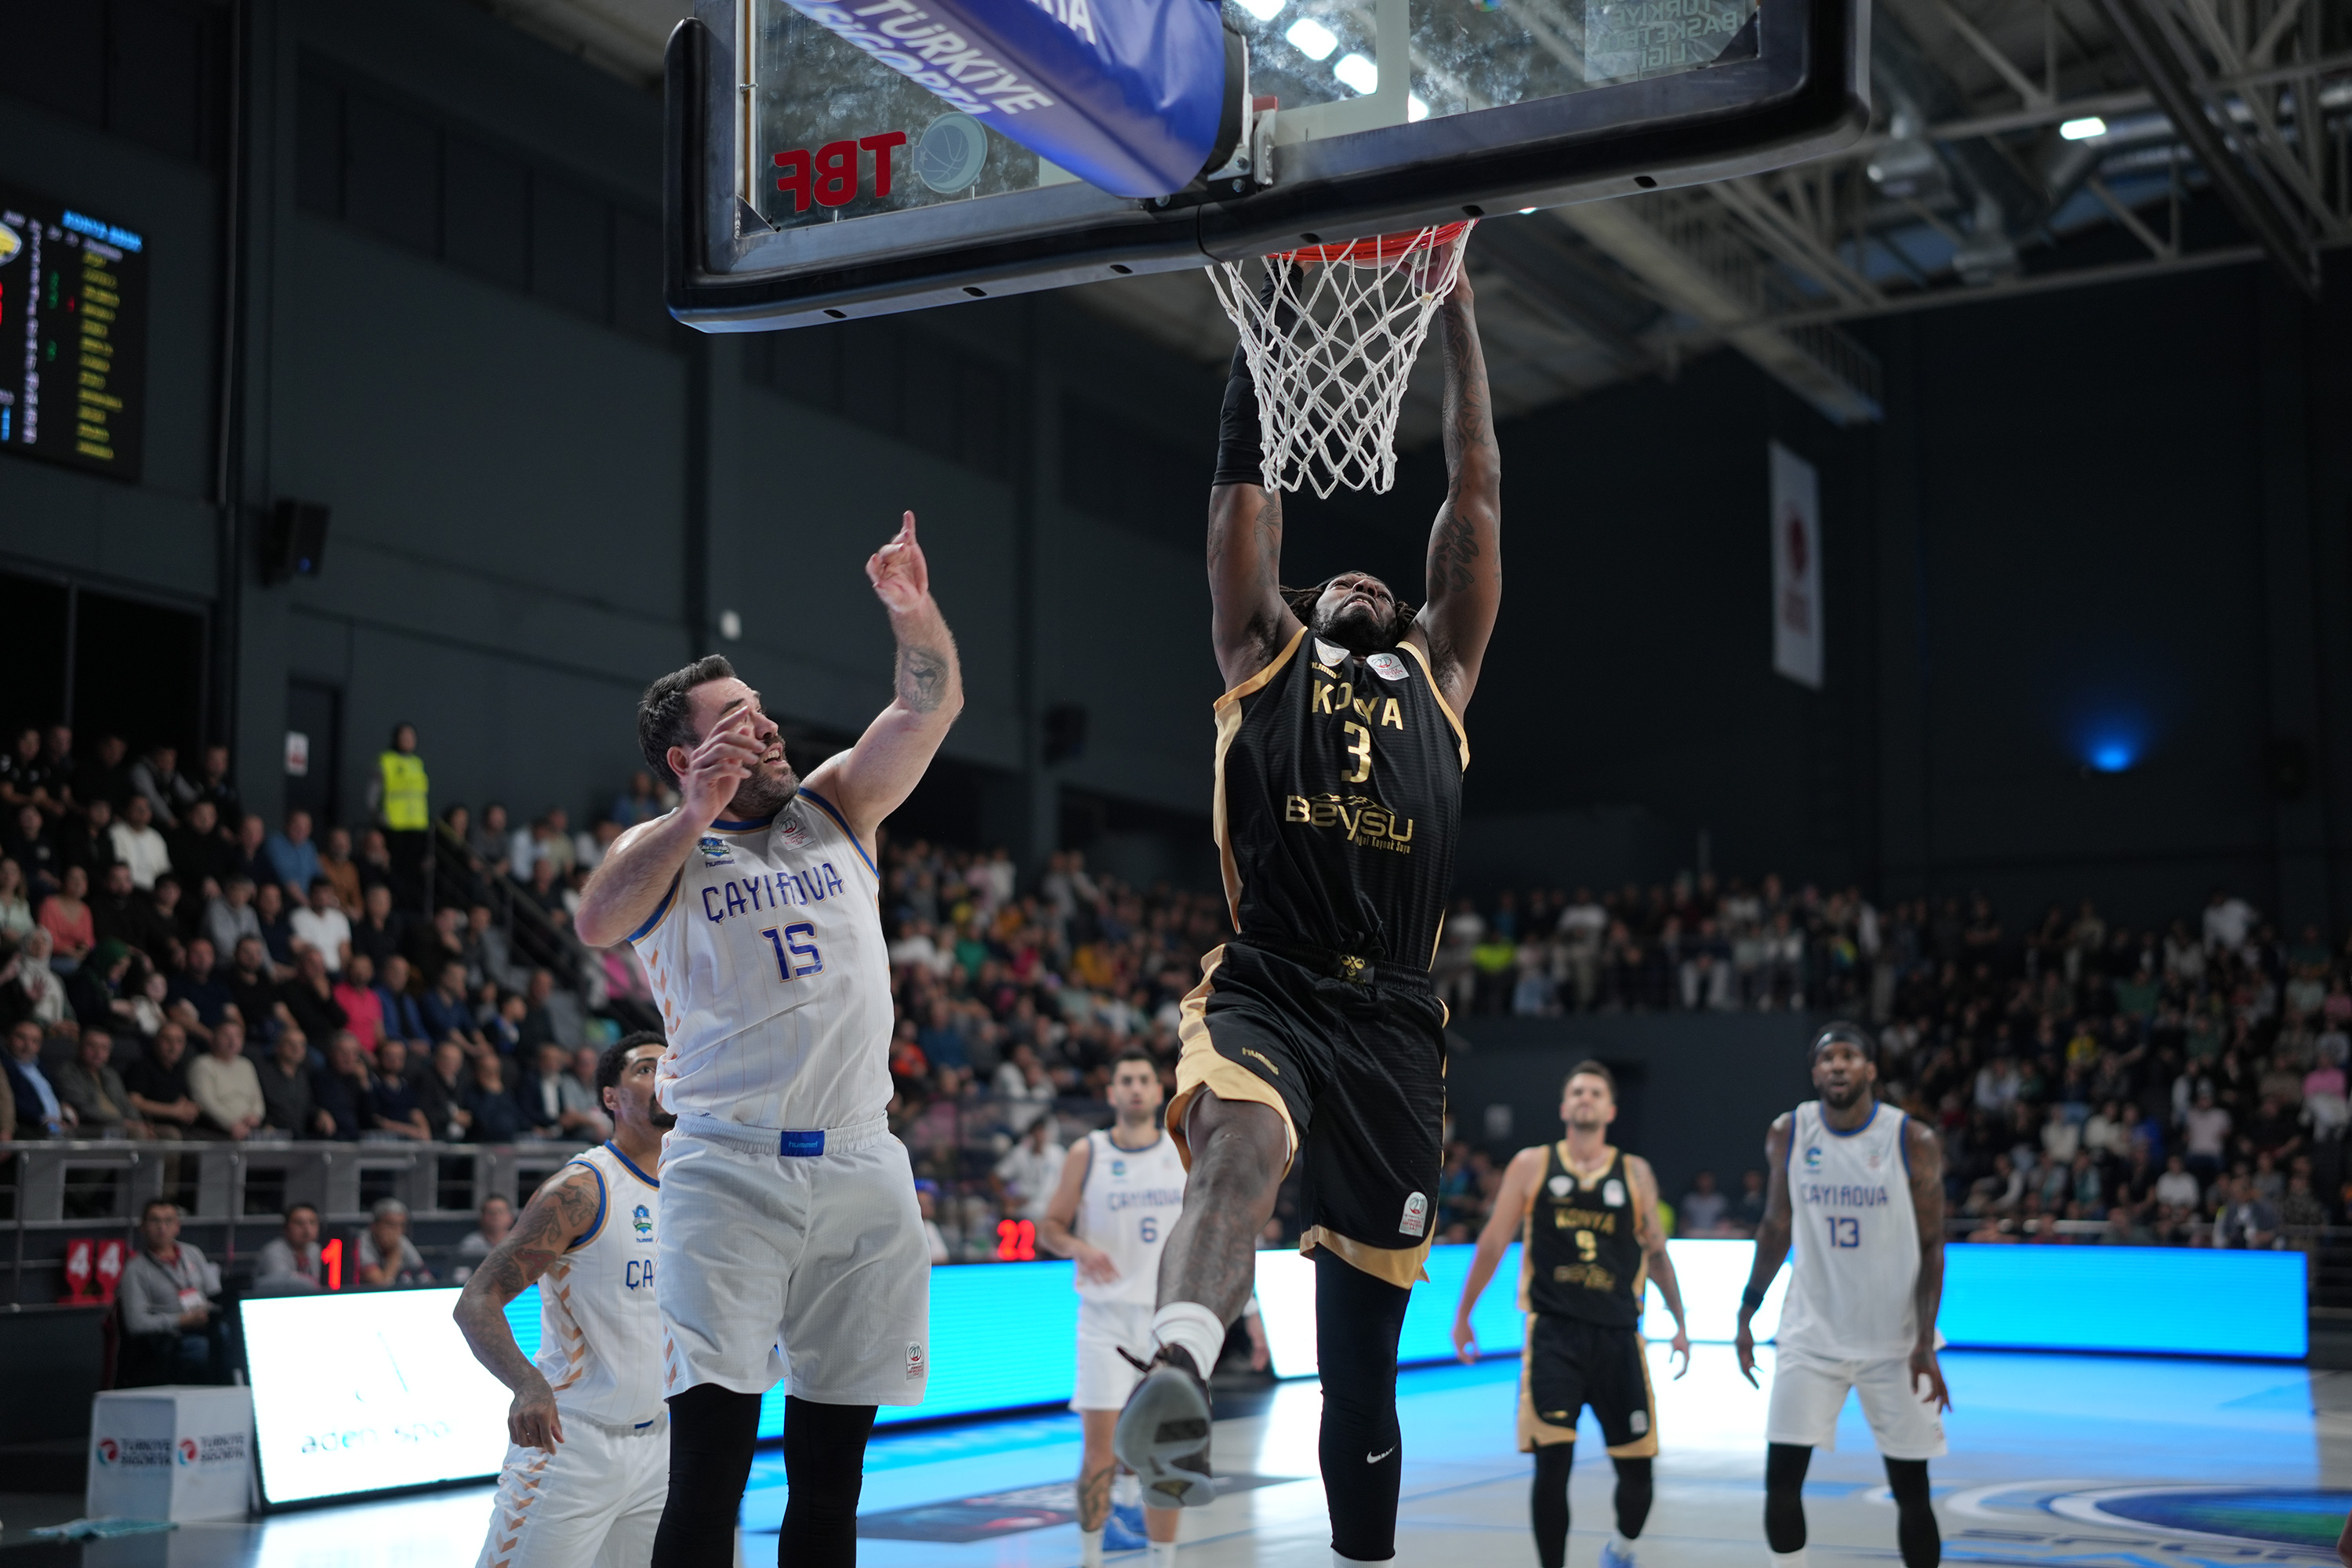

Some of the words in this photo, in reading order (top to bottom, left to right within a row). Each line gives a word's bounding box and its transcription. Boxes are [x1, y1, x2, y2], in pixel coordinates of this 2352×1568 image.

[855, 0, 1054, 115] TÜRKİYE
[1312, 680, 1403, 730] KOYA
[1341, 720, 1371, 783] 3
[759, 920, 826, 983] 15
[1140, 1217, 1158, 1243] 6
[1826, 1216, 1860, 1248] 13
[321, 1238, 343, 1290] 1
[394, 1420, 458, 1447] spo
